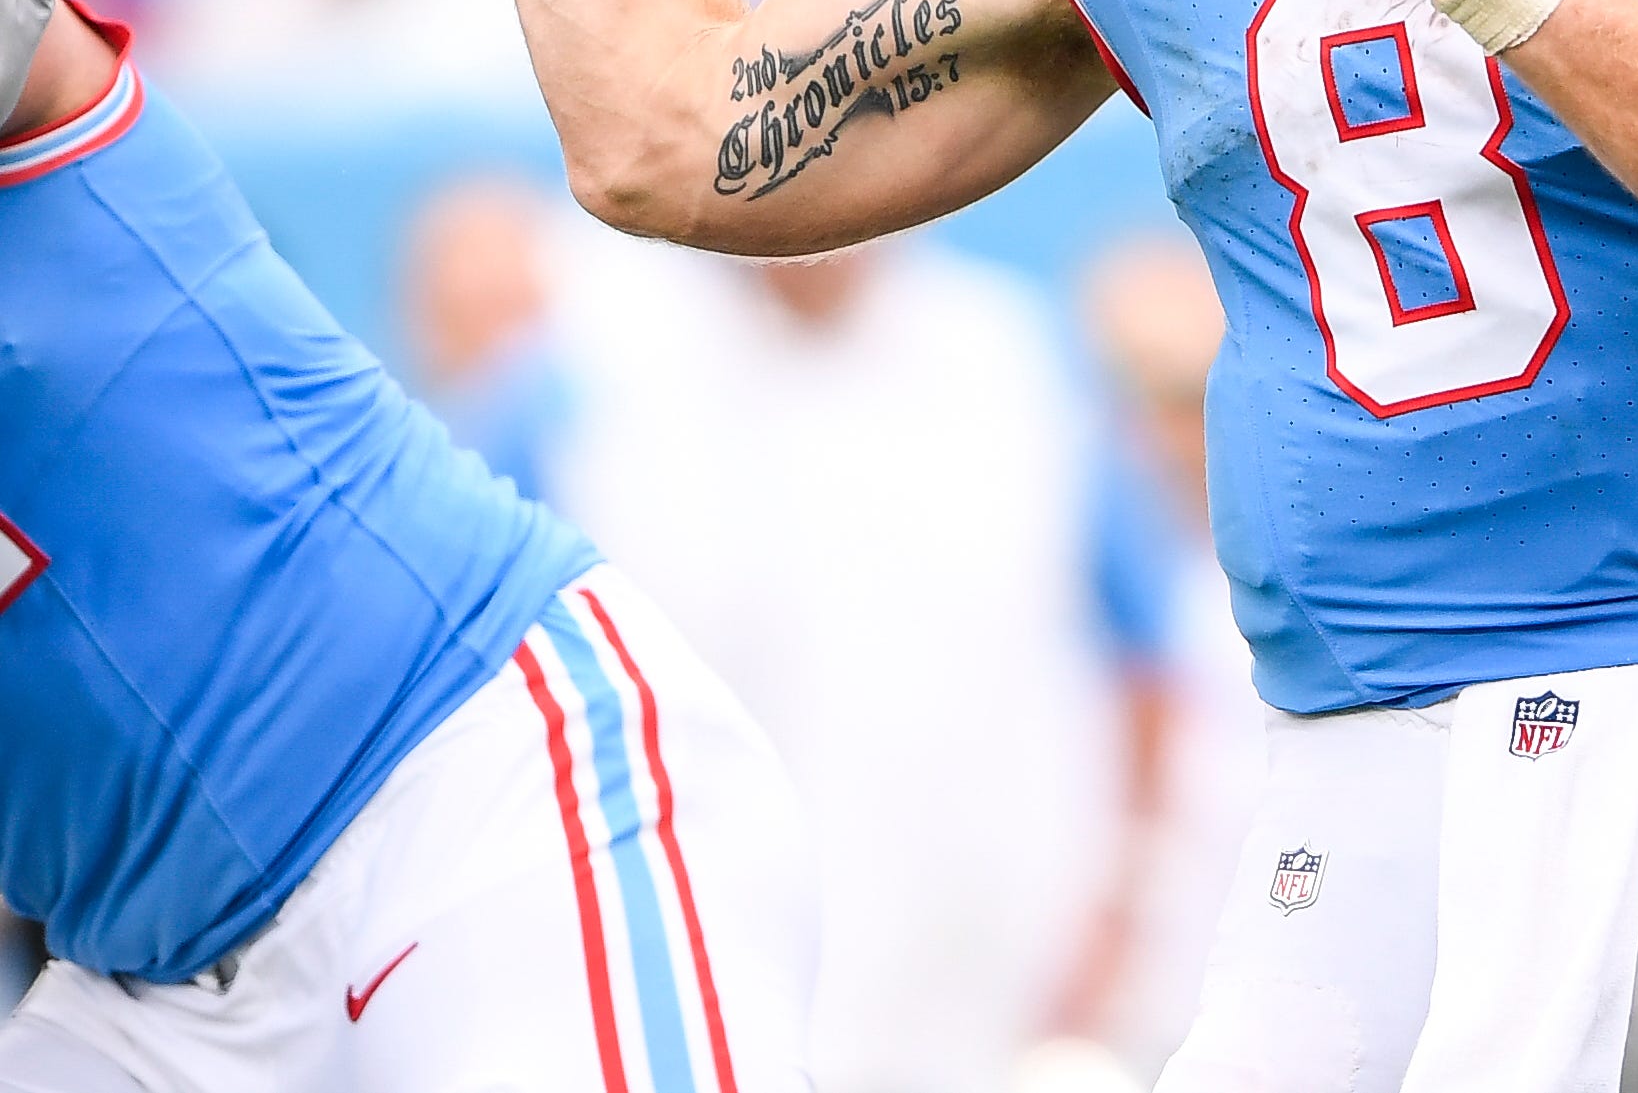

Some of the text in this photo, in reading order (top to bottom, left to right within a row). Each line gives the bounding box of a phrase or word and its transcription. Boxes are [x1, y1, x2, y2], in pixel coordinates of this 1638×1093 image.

[730, 42, 778, 102] 2nd
[891, 52, 961, 111] 15:7
[1514, 723, 1565, 756] NFL
[1274, 872, 1309, 900] NFL
